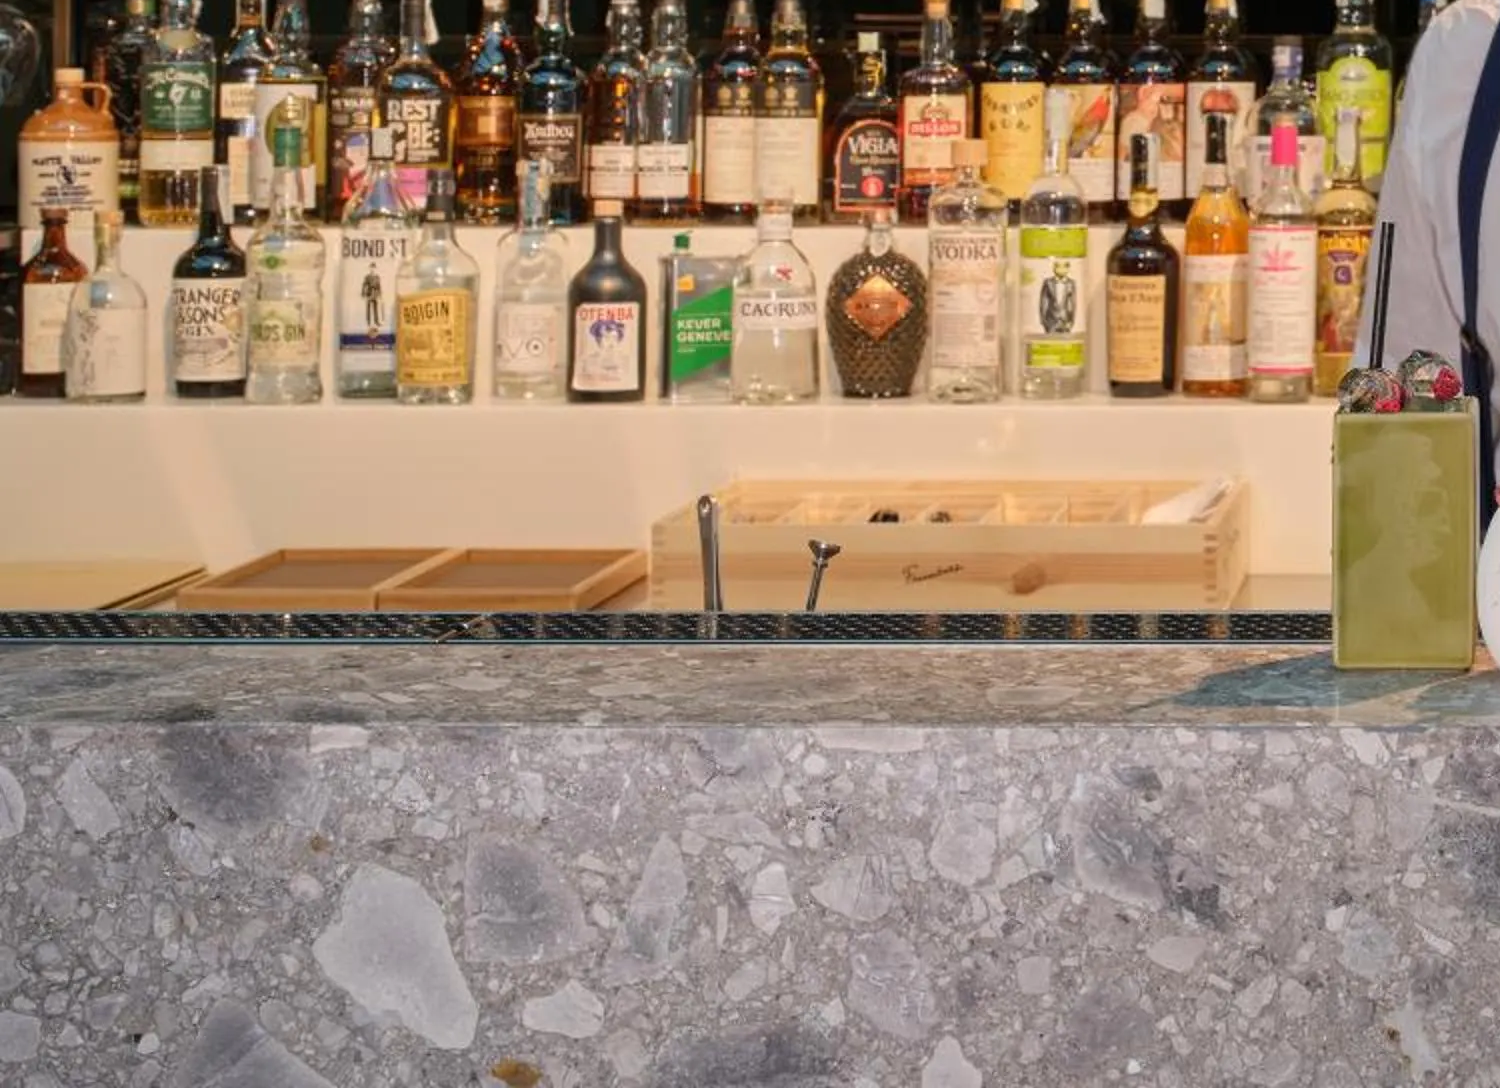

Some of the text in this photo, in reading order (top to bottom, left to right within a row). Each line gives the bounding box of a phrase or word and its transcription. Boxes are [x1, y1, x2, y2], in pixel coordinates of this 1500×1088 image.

[387, 99, 442, 120] REST
[341, 237, 385, 258] BOND
[935, 245, 997, 260] VODKA
[172, 287, 241, 305] TRANGER
[677, 318, 721, 329] KEVER
[677, 331, 732, 343] GENEVE
